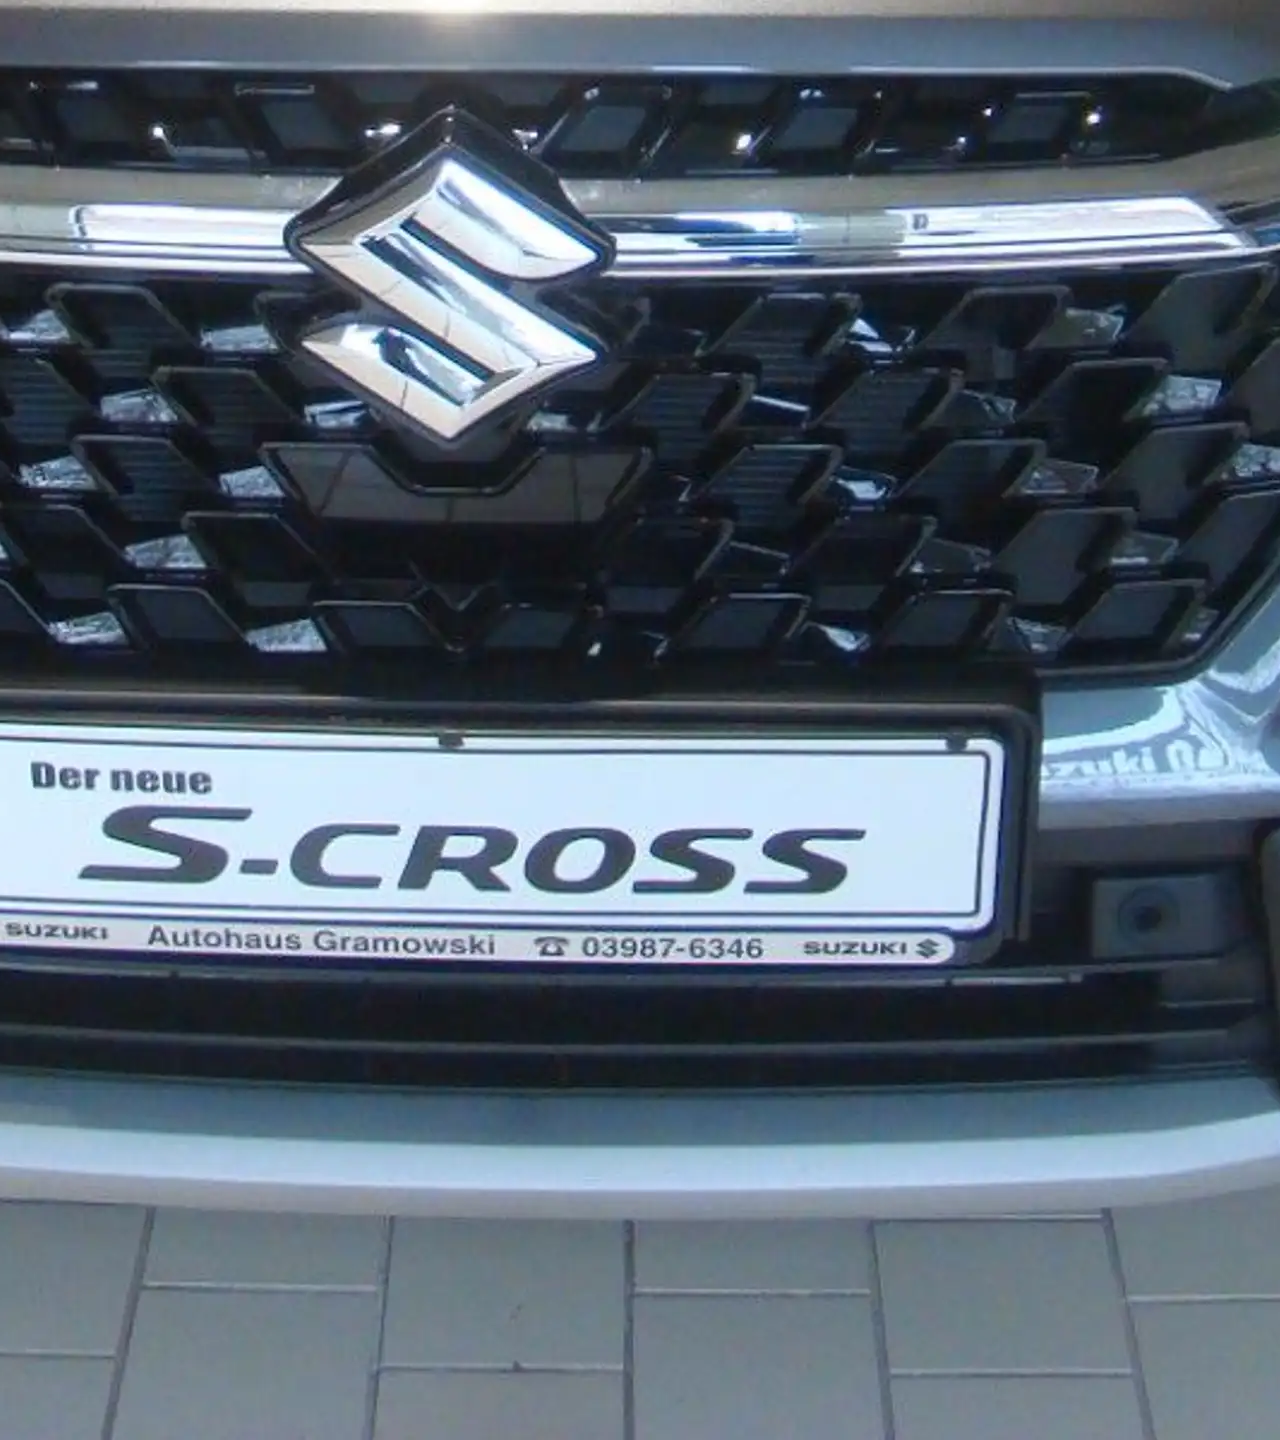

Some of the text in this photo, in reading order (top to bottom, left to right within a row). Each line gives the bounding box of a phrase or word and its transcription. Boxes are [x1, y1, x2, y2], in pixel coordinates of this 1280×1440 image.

[30, 761, 214, 795] Der neue
[78, 805, 867, 894] S-CROSS
[5, 922, 908, 960] SUZUKI Autohaus Gramowski 03987-6346 SUZUKI
